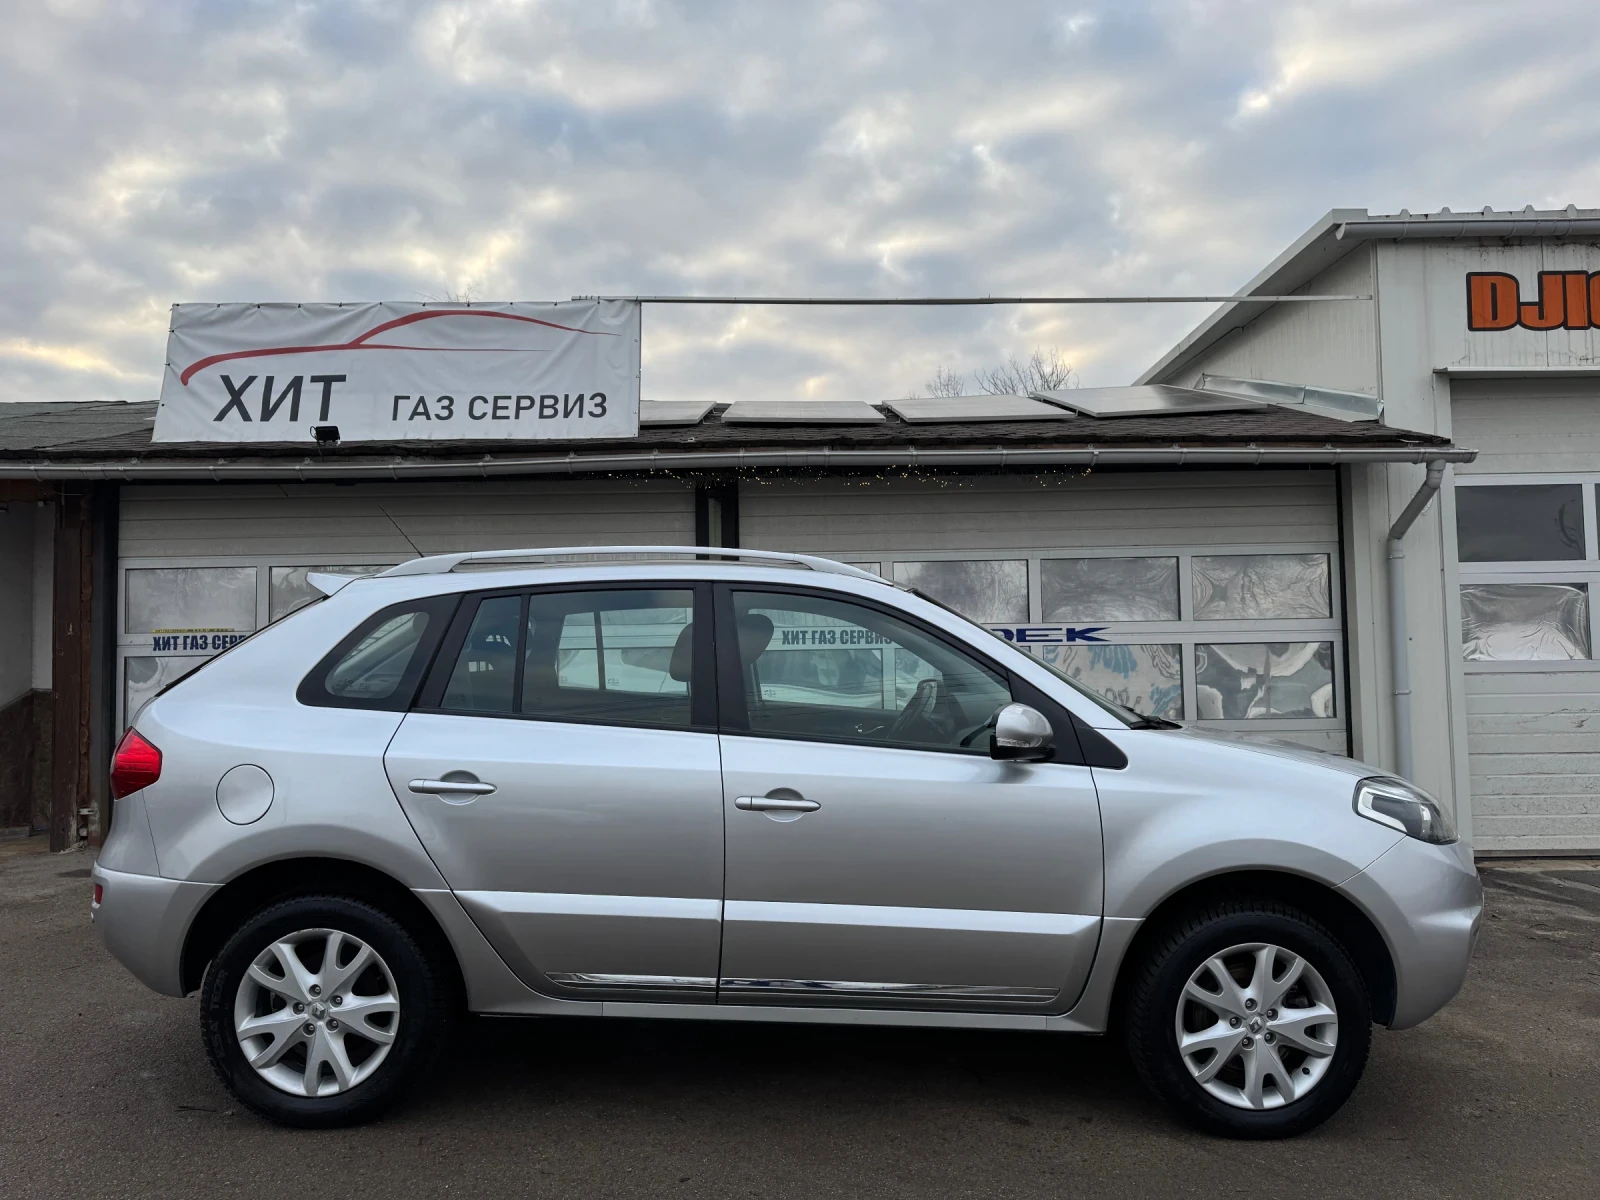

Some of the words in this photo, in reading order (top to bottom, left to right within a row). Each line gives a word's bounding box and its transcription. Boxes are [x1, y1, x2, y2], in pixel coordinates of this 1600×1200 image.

[1466, 270, 1600, 331] DJI
[213, 374, 347, 422] ХИТ
[392, 395, 454, 421] ГАЗ
[468, 392, 607, 420] СЕРВИЗ
[152, 635, 180, 652] ХИТ
[182, 635, 208, 650] ГАЗ
[211, 634, 247, 650] СЕР
[781, 630, 808, 645] ХИТ
[811, 630, 837, 645] ГАЗ
